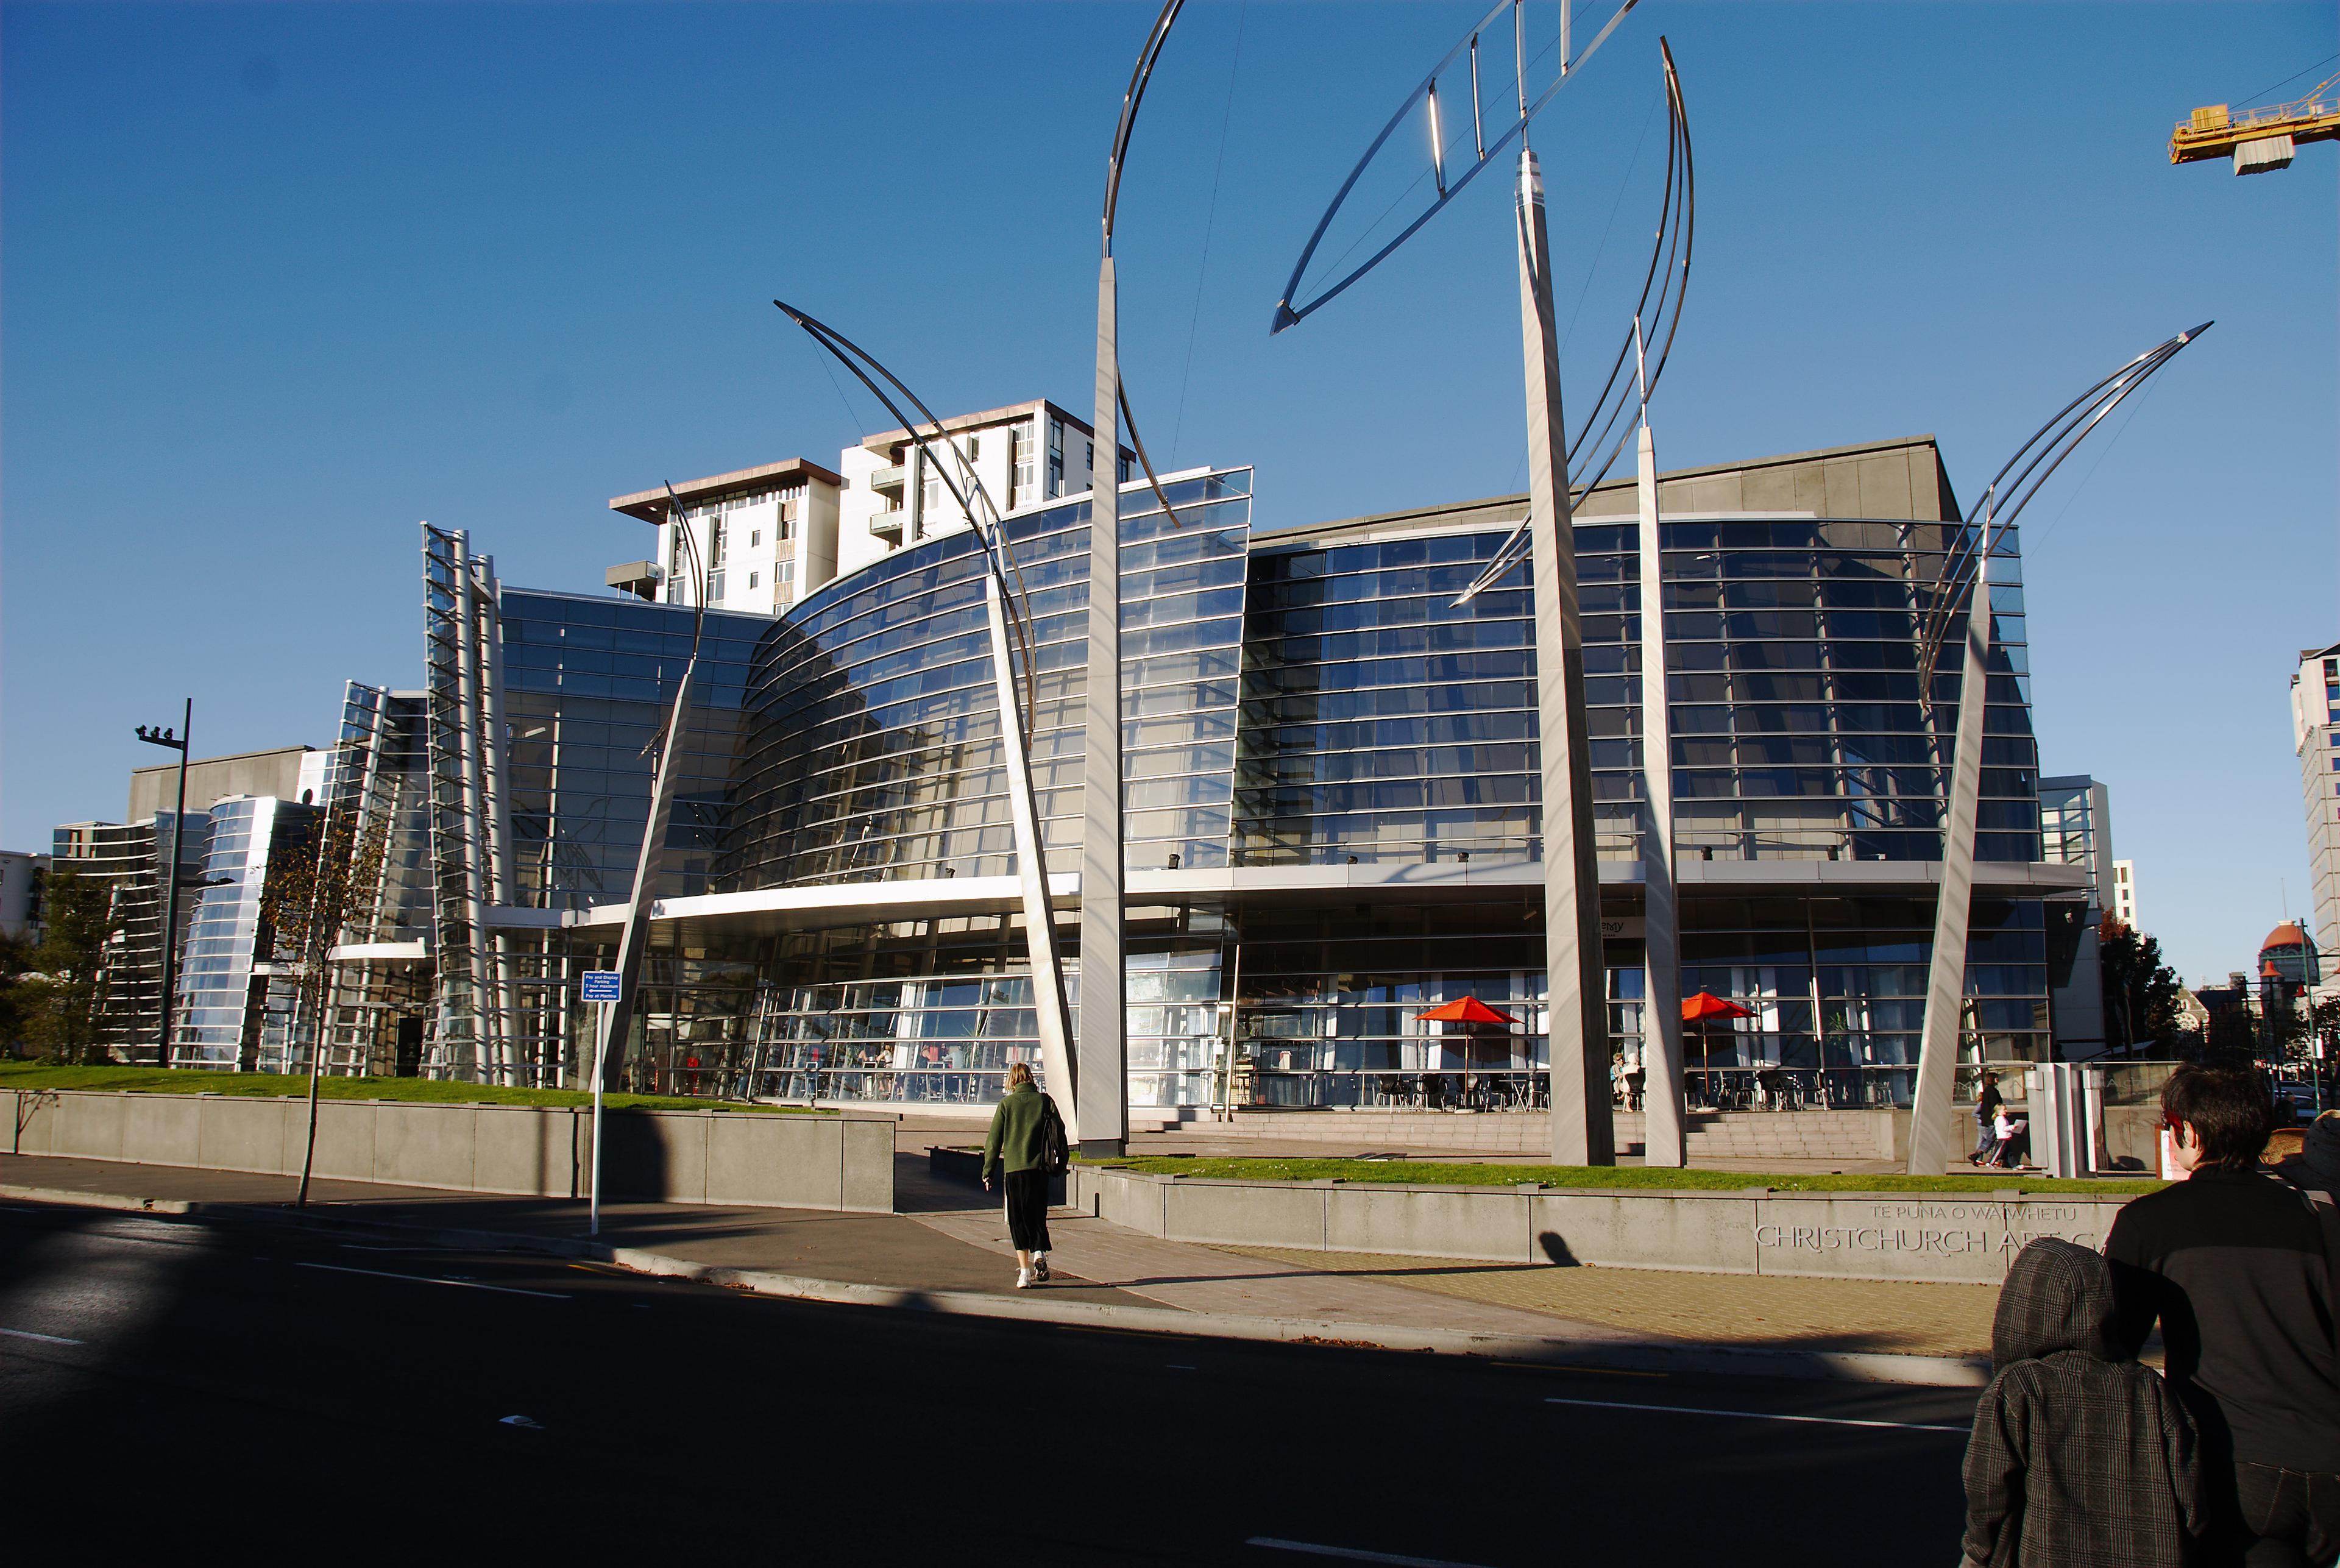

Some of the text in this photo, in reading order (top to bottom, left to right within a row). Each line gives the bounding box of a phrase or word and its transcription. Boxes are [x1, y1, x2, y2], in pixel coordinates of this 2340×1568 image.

[1601, 921, 1624, 932] emy
[1870, 1205, 1891, 1218] TE
[1896, 1205, 1947, 1219] PUNA
[1952, 1206, 1966, 1219] O
[1755, 1225, 1986, 1257] CHRISTCHURCH
